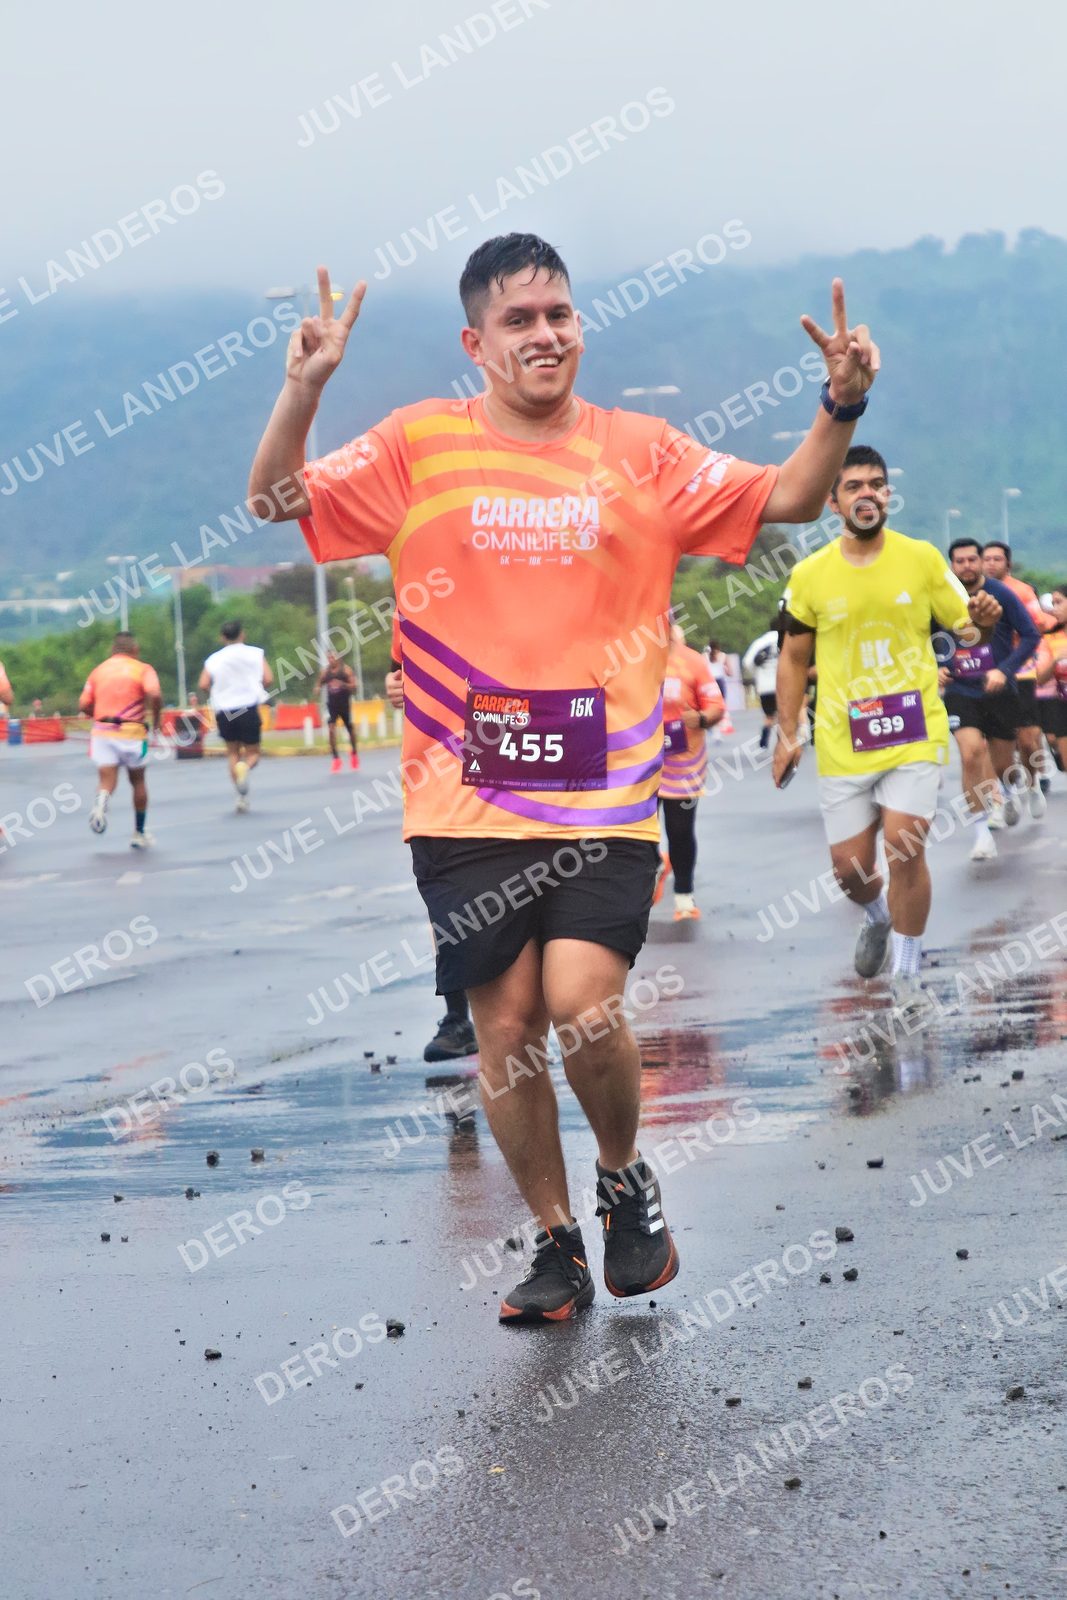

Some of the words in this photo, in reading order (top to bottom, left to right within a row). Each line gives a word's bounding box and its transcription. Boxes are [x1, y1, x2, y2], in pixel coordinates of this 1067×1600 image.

[471, 496, 599, 528] CARRERA
[472, 531, 571, 551] OMNILIFE
[473, 694, 530, 714] CARRERA
[570, 697, 595, 718] 15K
[868, 715, 905, 737] 639
[499, 732, 564, 763] 455
